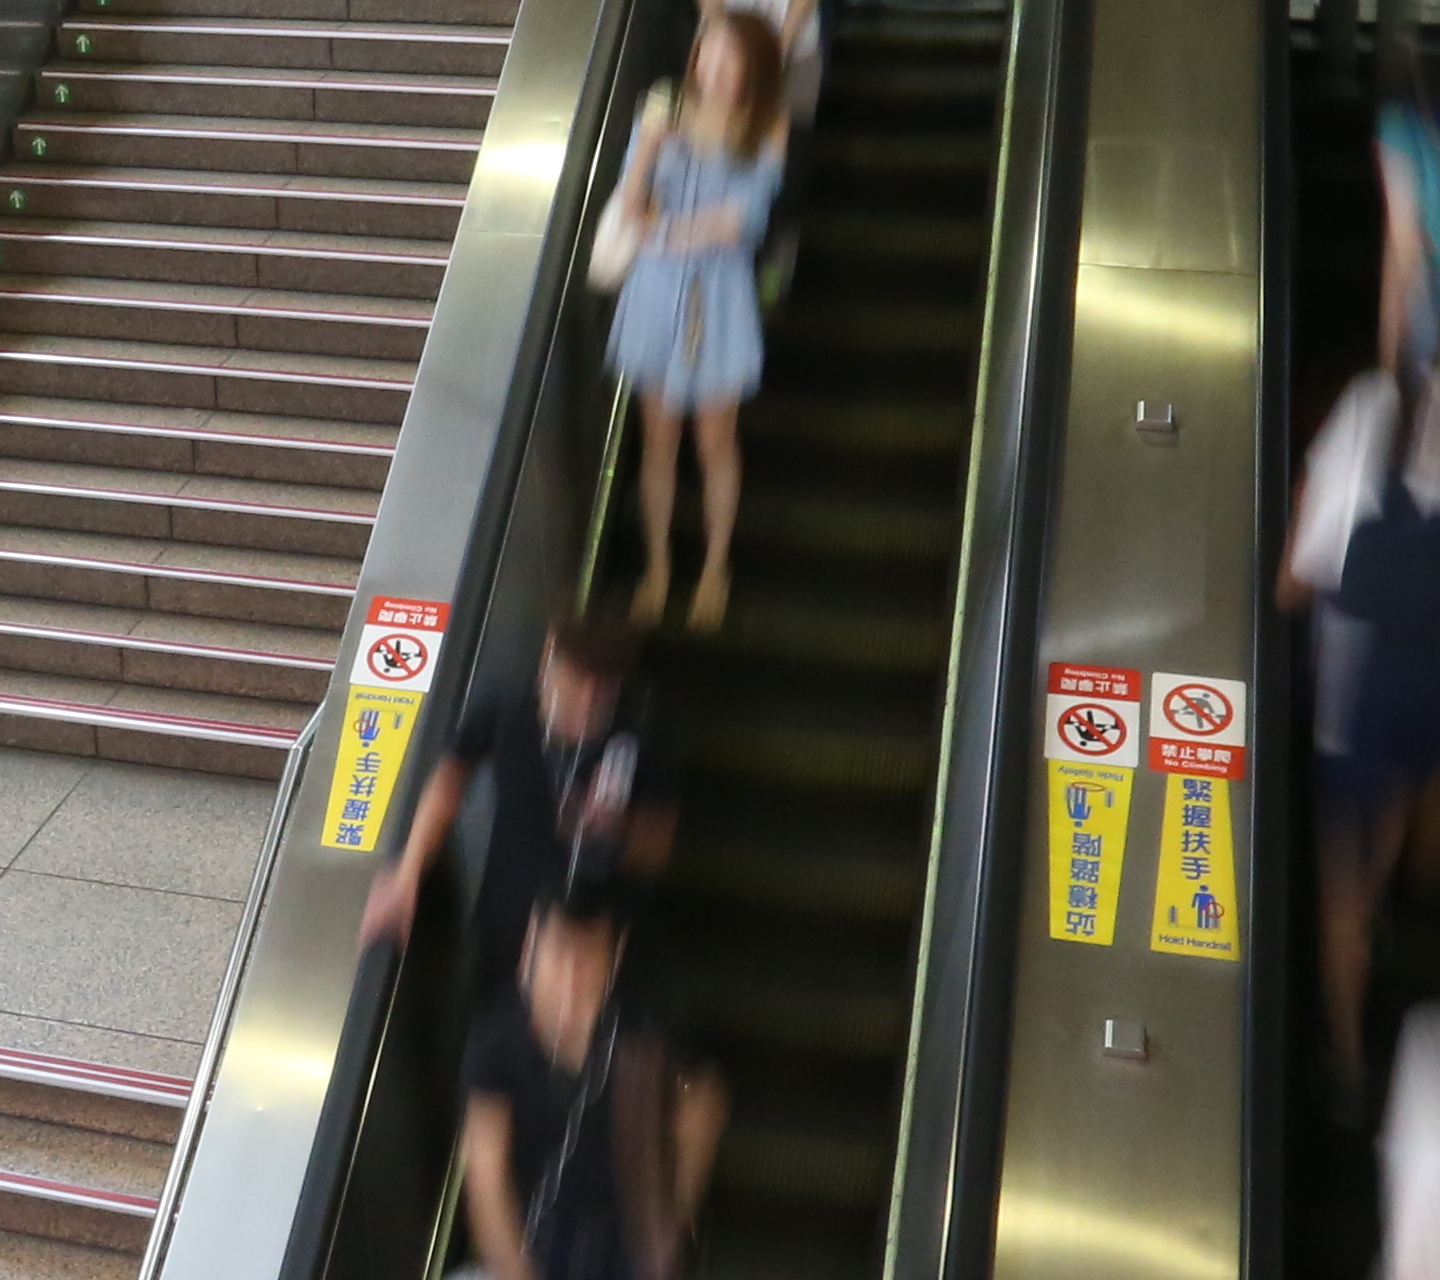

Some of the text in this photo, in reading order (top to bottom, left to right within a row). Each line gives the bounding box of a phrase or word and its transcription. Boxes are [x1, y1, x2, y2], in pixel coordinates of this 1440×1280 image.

[335, 751, 382, 846] 緊握扶手
[1164, 758, 1228, 774] No Climbing
[1181, 778, 1212, 880] 緊握扶手
[1065, 832, 1102, 937] 站穩踏階
[1159, 934, 1233, 951] Hold Handrail
